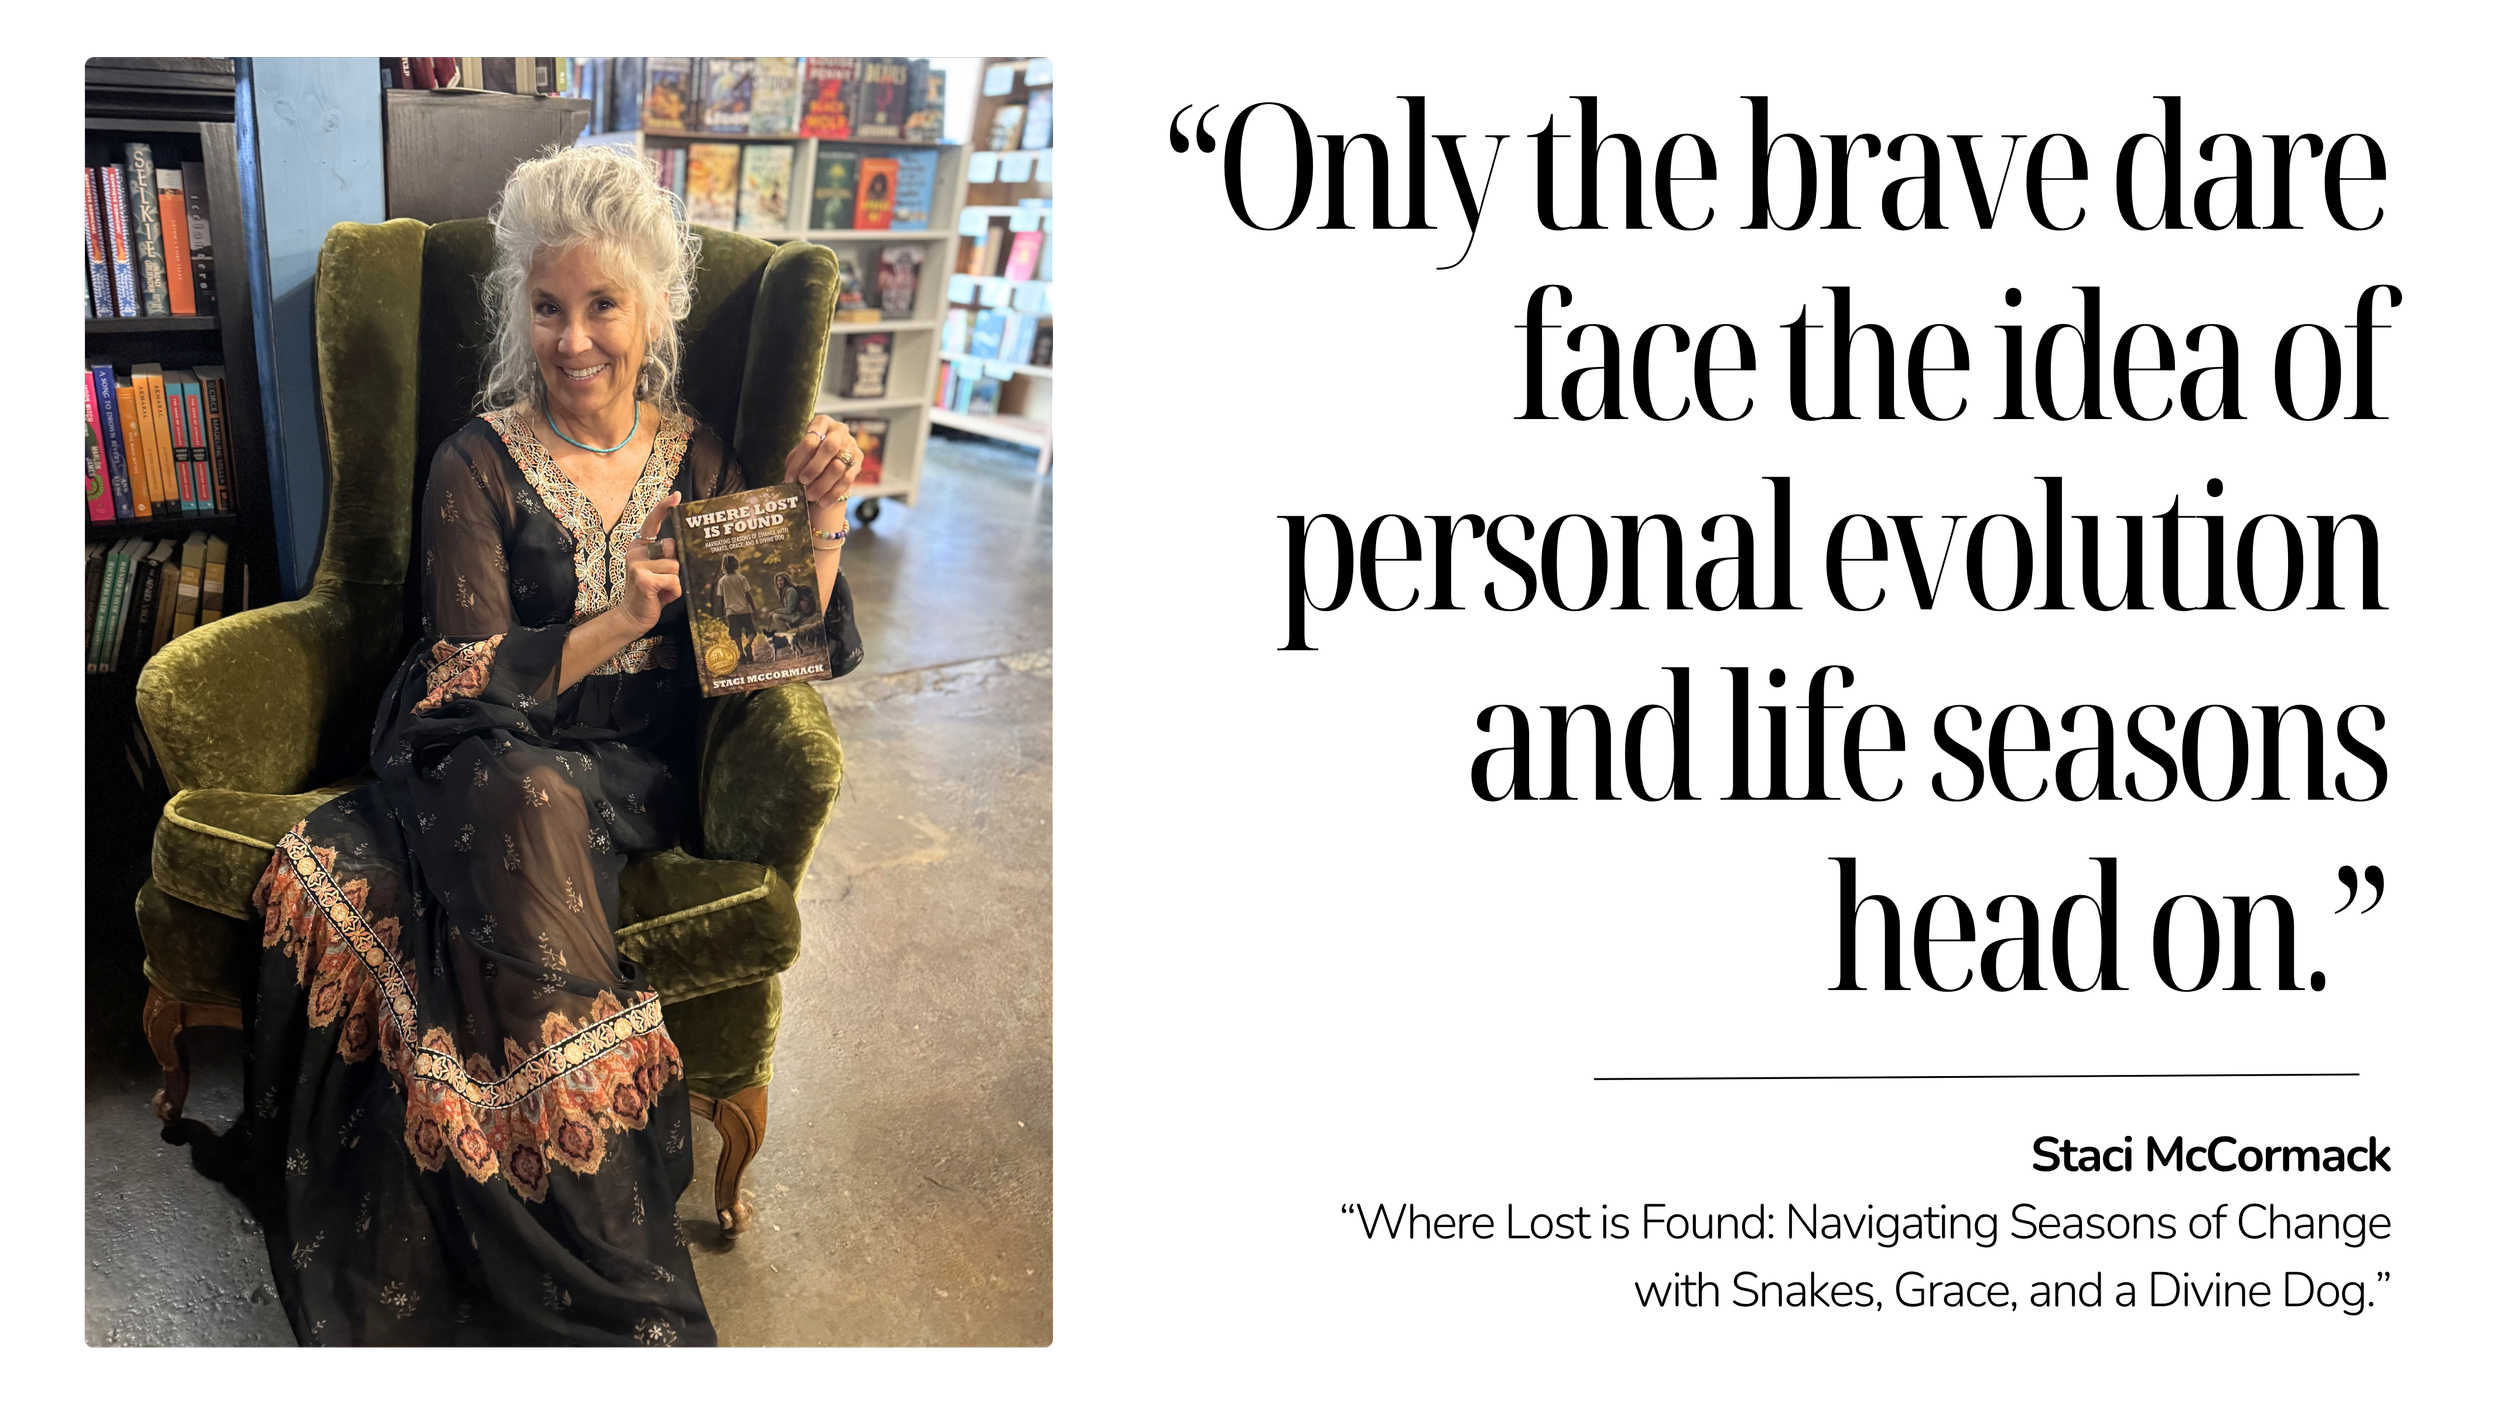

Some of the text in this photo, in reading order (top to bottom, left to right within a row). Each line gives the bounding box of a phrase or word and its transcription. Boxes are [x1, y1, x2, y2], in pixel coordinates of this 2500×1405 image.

[133, 150, 156, 258] SELKIE
[101, 378, 110, 398] SONG
[85, 403, 94, 422] WITCH
[104, 400, 112, 410] TO
[138, 386, 148, 420] AKMARAL
[154, 384, 163, 418] AKMARAL
[209, 389, 218, 412] CIRCE
[106, 411, 116, 439] DROWN
[91, 445, 101, 470] MARLON
[111, 440, 120, 464] RIVERS
[213, 419, 226, 484] MADELINE MILLER
[85, 457, 96, 477] JAMES
[114, 476, 122, 497] LIANG
[121, 478, 129, 493] ANN
[685, 496, 799, 529] WHERE LOST
[703, 513, 785, 539] IS FOUND
[705, 538, 731, 548] NAVIGATING
[731, 534, 752, 544] SEASONS
[758, 530, 776, 538] CHANGE
[713, 664, 824, 689] STACI MCCORMACK
